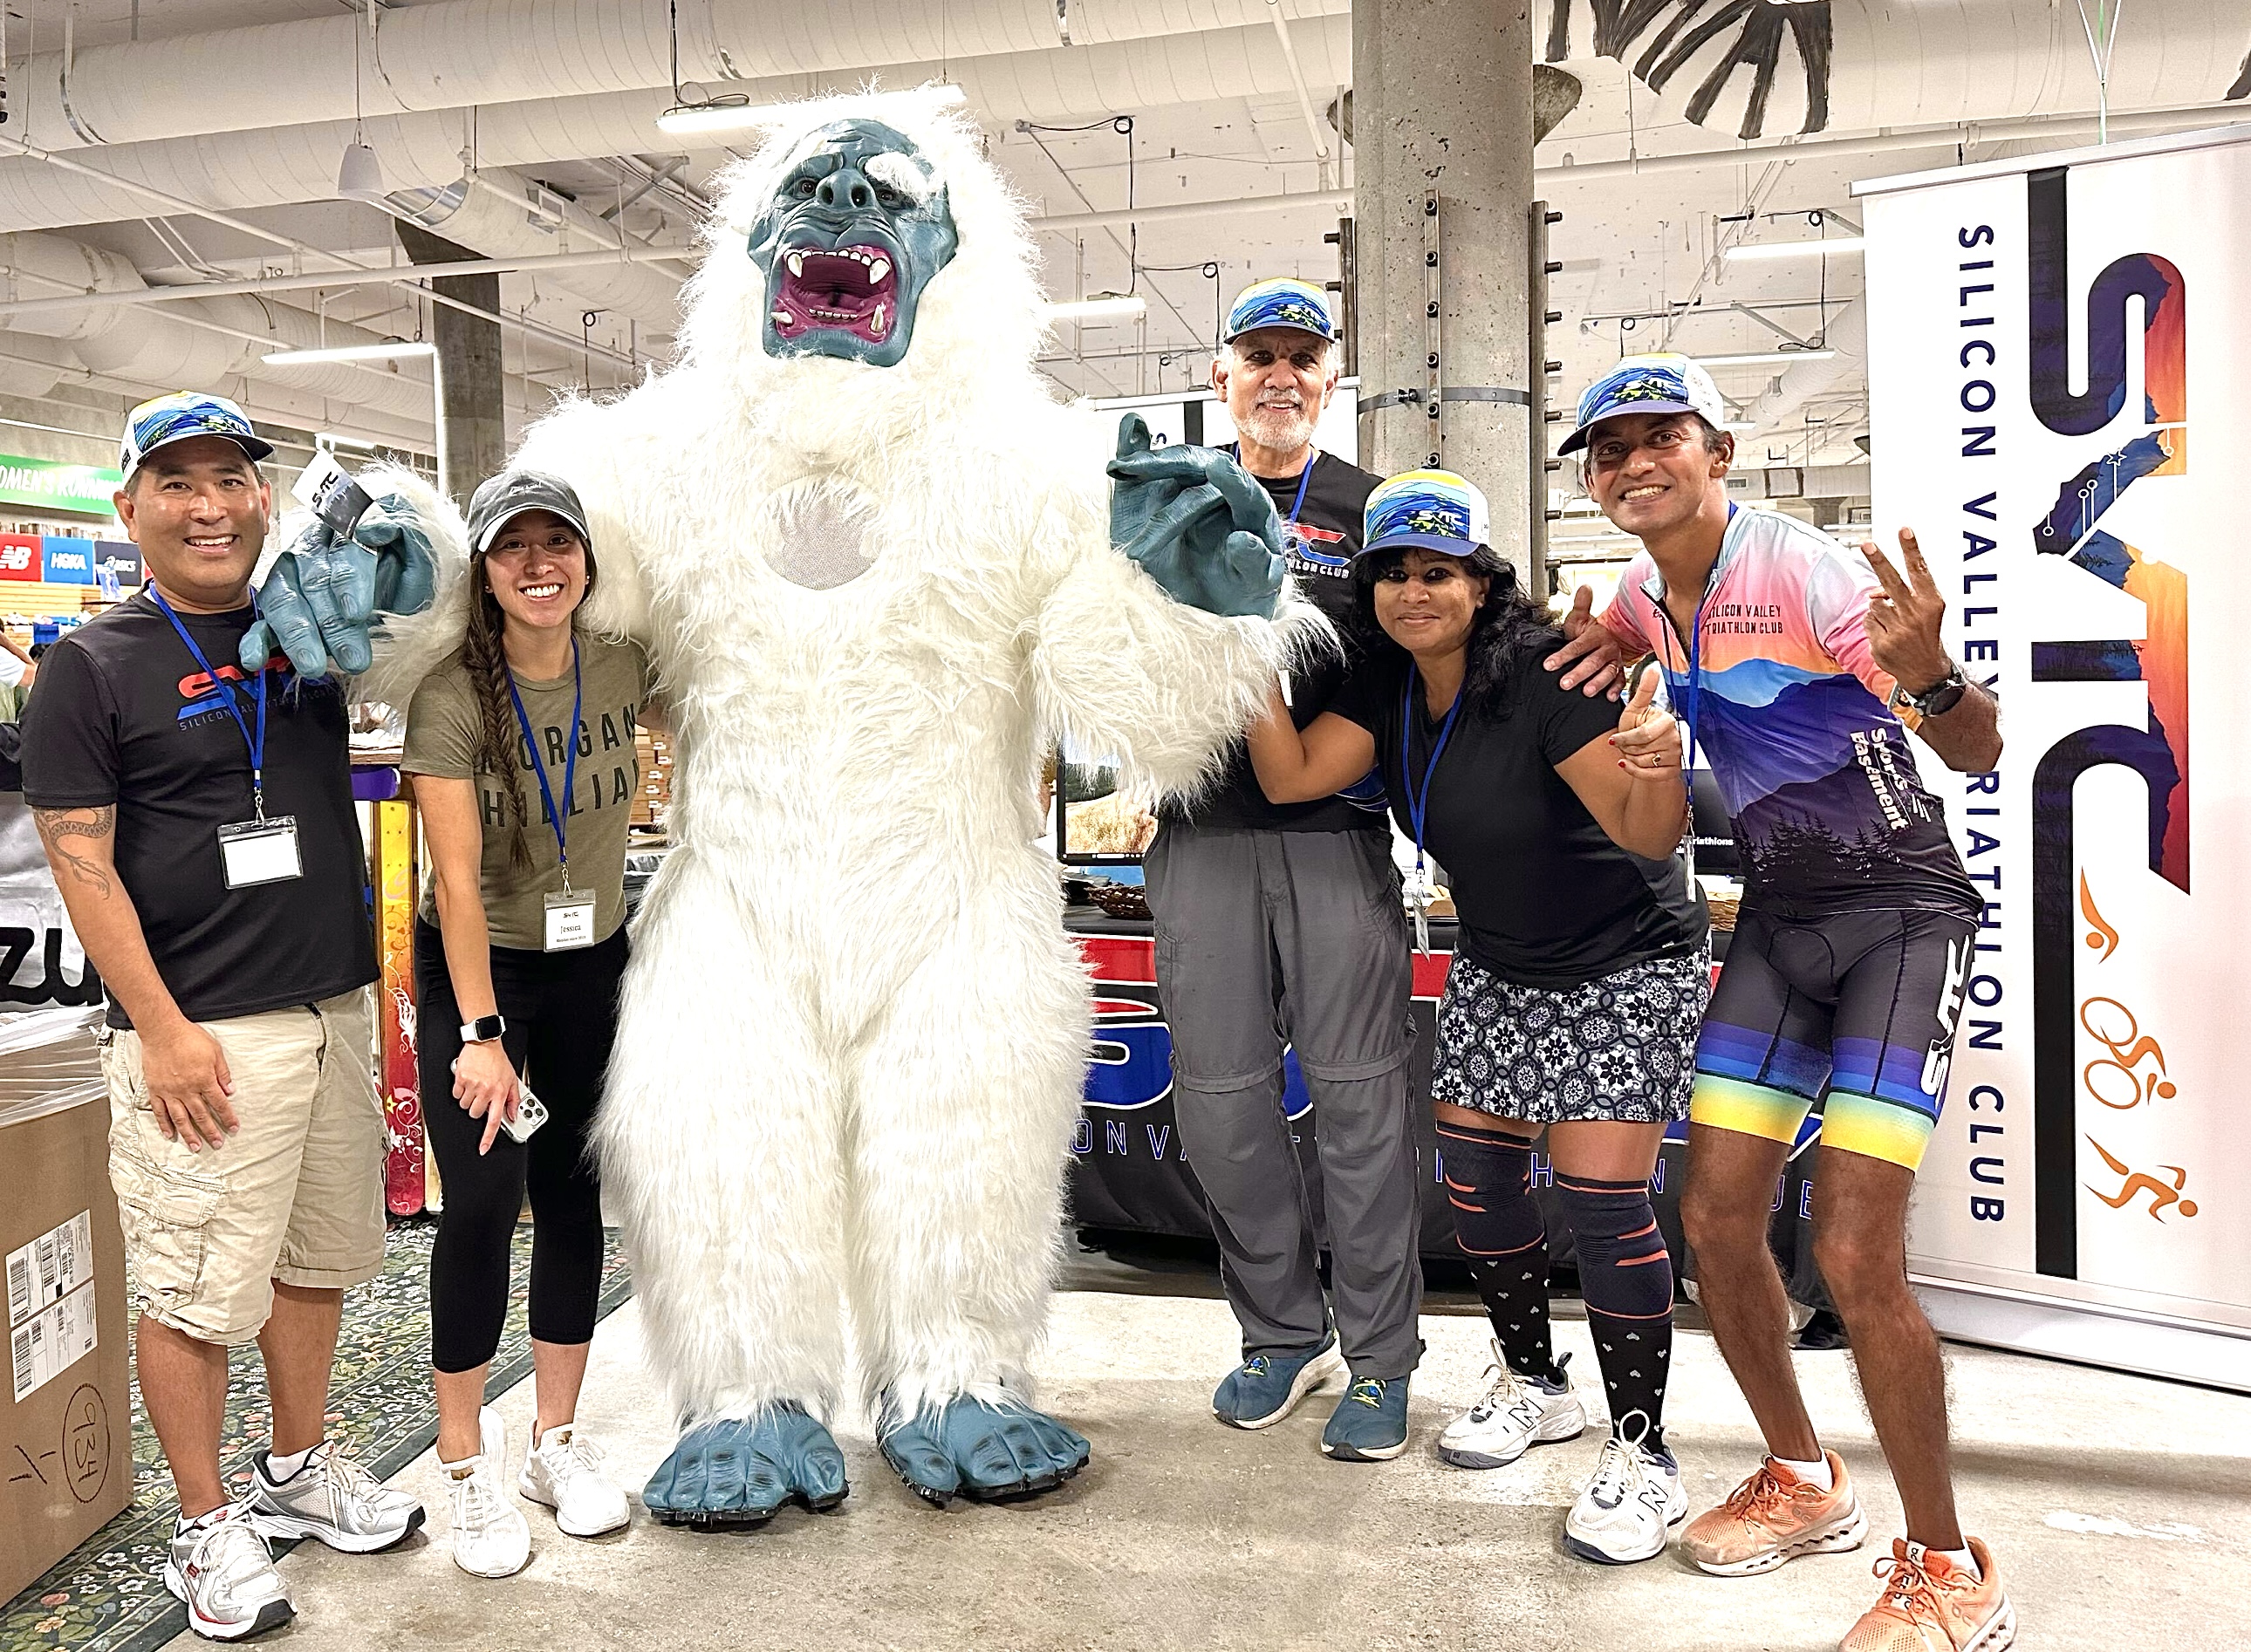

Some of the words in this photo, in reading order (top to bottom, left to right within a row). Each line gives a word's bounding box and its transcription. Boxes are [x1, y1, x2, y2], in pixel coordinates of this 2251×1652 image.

[1959, 224, 1996, 457] SILICON
[51, 552, 86, 570] HOKA
[1319, 565, 1350, 579] CLUB
[1705, 621, 1756, 635] TRIATHLON
[1759, 622, 1783, 635] CLUB
[1707, 604, 1742, 619] SILICON
[1745, 604, 1781, 618] VALLEY
[179, 708, 233, 732] SILICON
[482, 702, 636, 774] ORGAN
[1850, 731, 1910, 830] Basement
[1871, 727, 1909, 791] Sports
[1966, 770, 2003, 1052] RIATHLON
[1968, 1084, 2004, 1223] CLUB
[72, 1402, 98, 1483] 934
